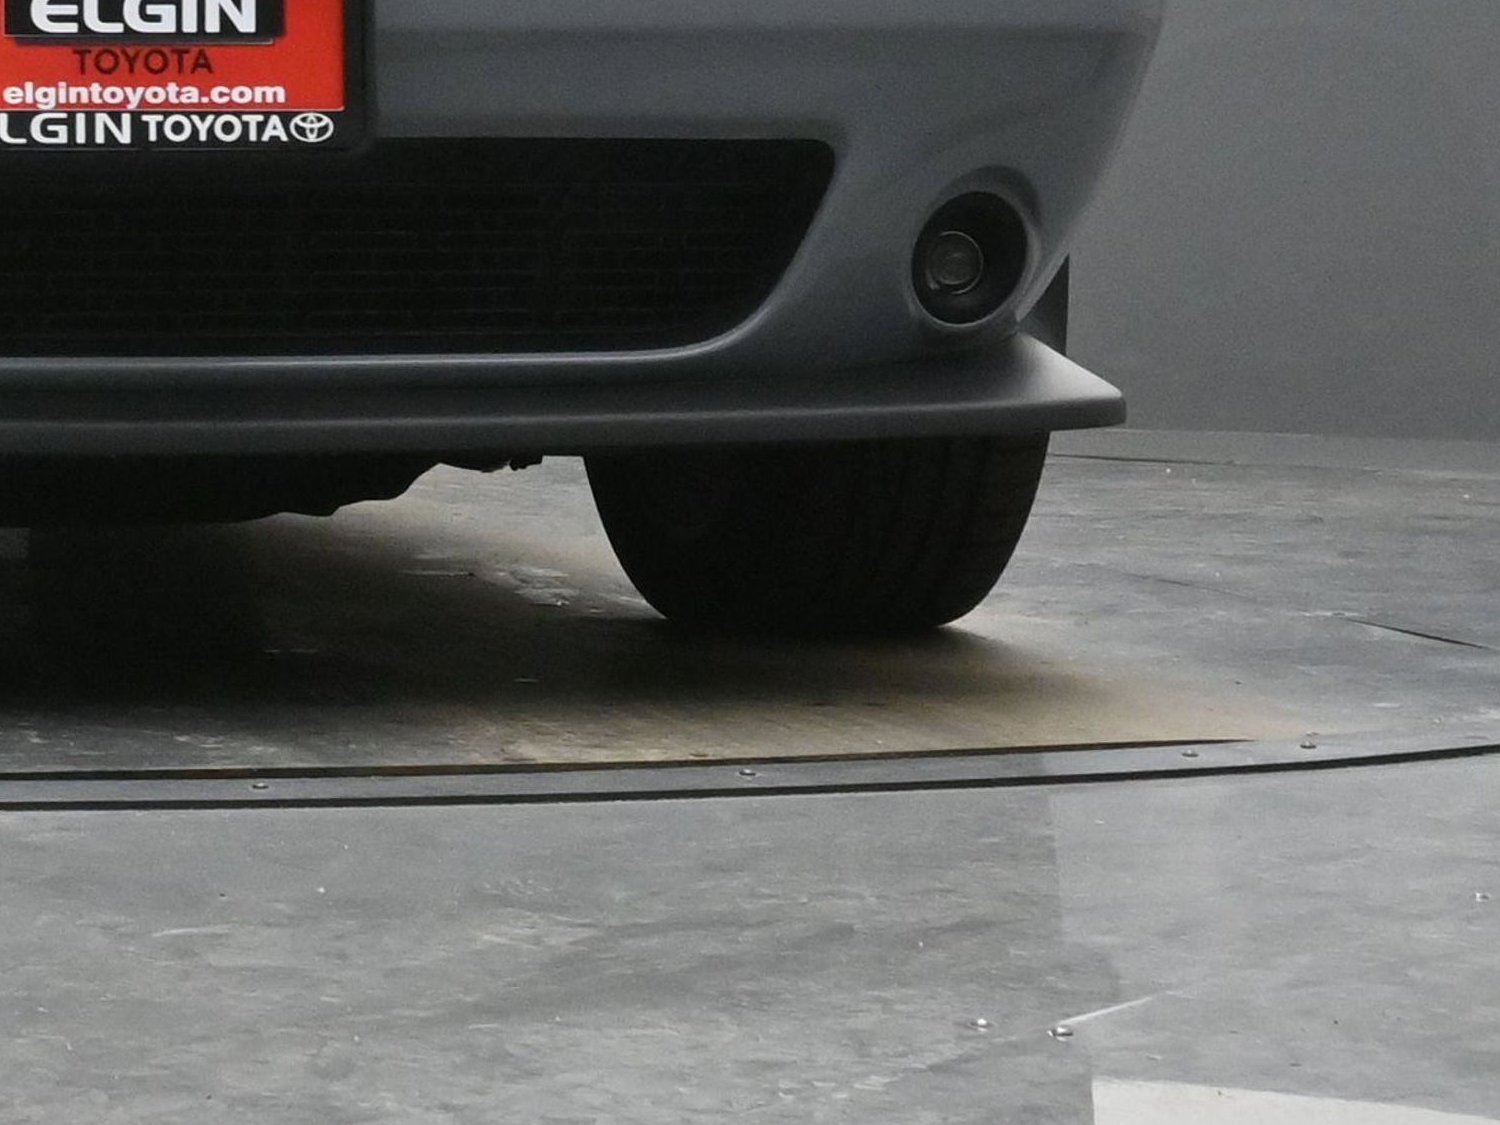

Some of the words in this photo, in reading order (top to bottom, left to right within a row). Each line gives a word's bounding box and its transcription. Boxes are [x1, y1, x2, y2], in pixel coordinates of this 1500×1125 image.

[73, 48, 214, 75] TOYOTA
[3, 81, 286, 109] elgintoyota.com
[141, 114, 288, 143] TOYOTA
